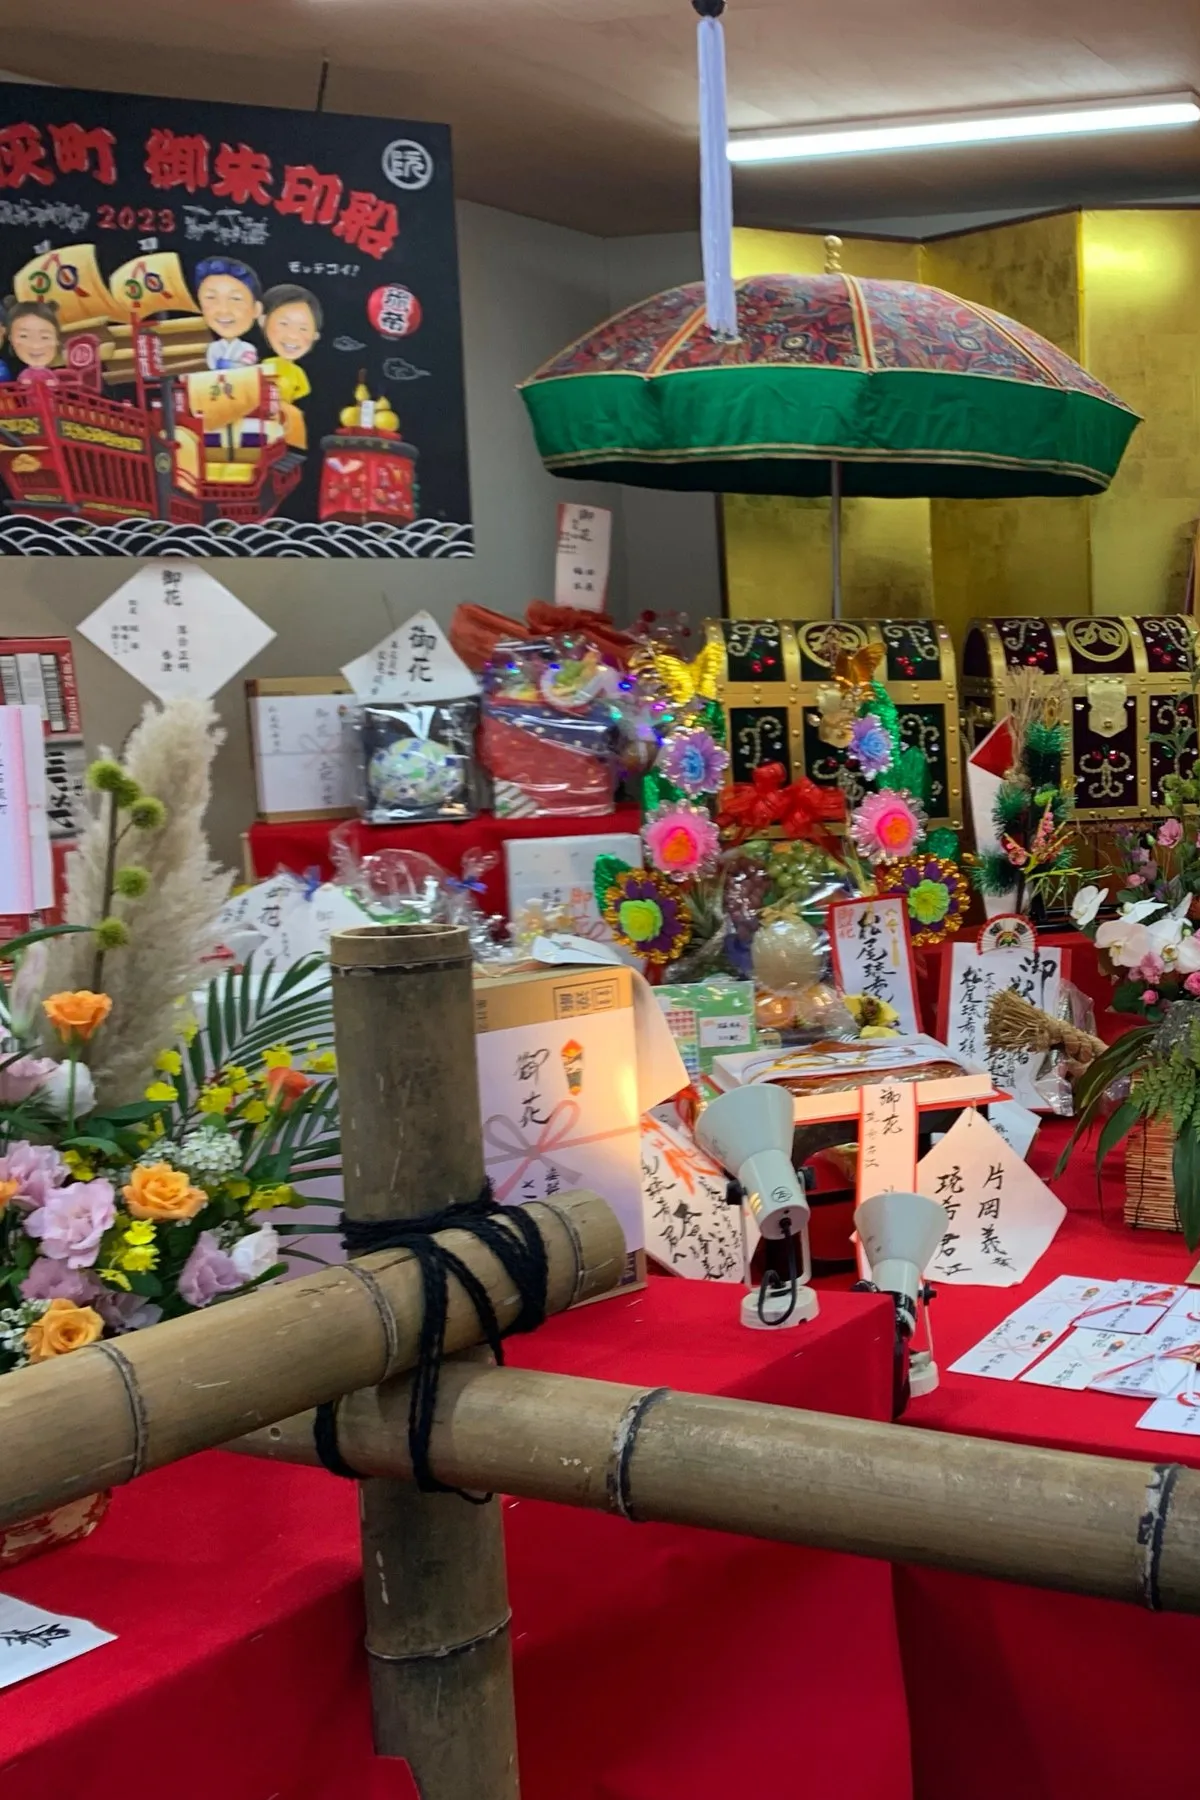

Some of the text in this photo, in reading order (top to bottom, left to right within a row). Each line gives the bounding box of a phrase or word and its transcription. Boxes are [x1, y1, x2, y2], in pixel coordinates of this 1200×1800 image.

[97, 204, 175, 232] 2023
[144, 128, 399, 260] 御朱印船
[408, 625, 437, 682] 御花
